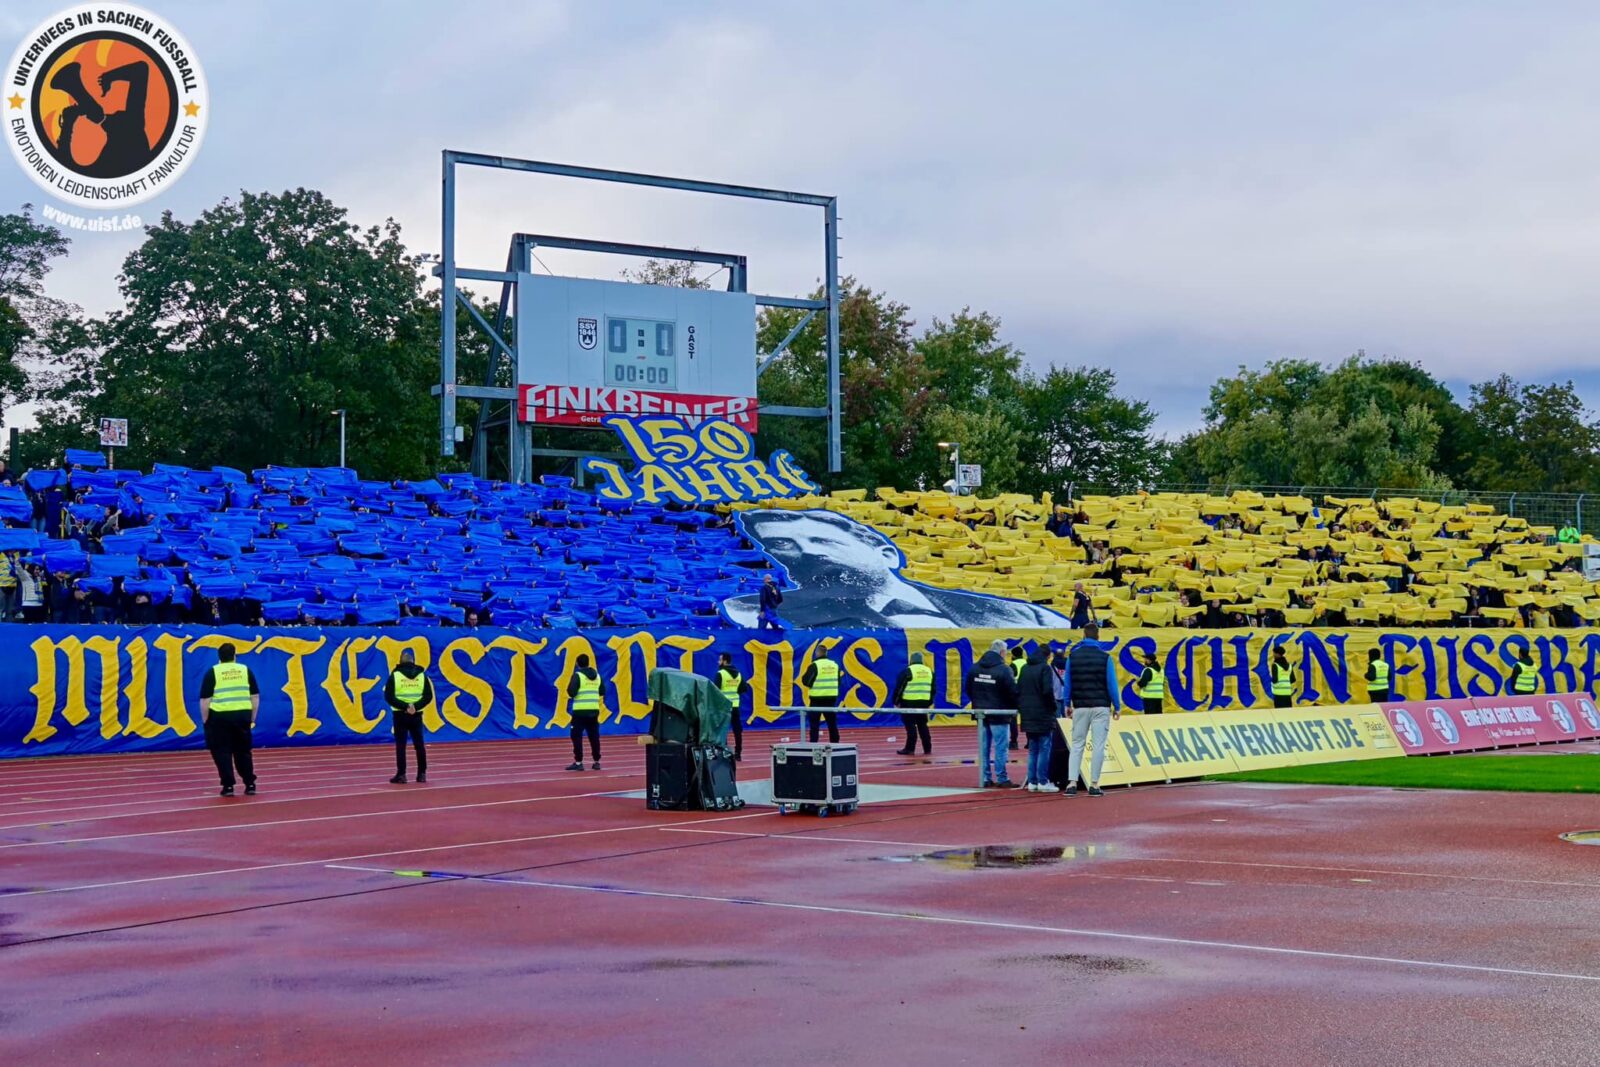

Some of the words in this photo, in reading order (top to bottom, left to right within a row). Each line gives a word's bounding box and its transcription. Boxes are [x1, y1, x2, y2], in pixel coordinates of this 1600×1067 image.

[579, 322, 596, 330] SSV
[687, 325, 696, 360] GAST
[615, 364, 669, 384] 00:00
[525, 384, 750, 431] FINKBEINER
[605, 417, 751, 464] 150
[925, 630, 1353, 721] DSCHEN
[1119, 718, 1365, 767] PLAKAT-VERKAUFT.DE
